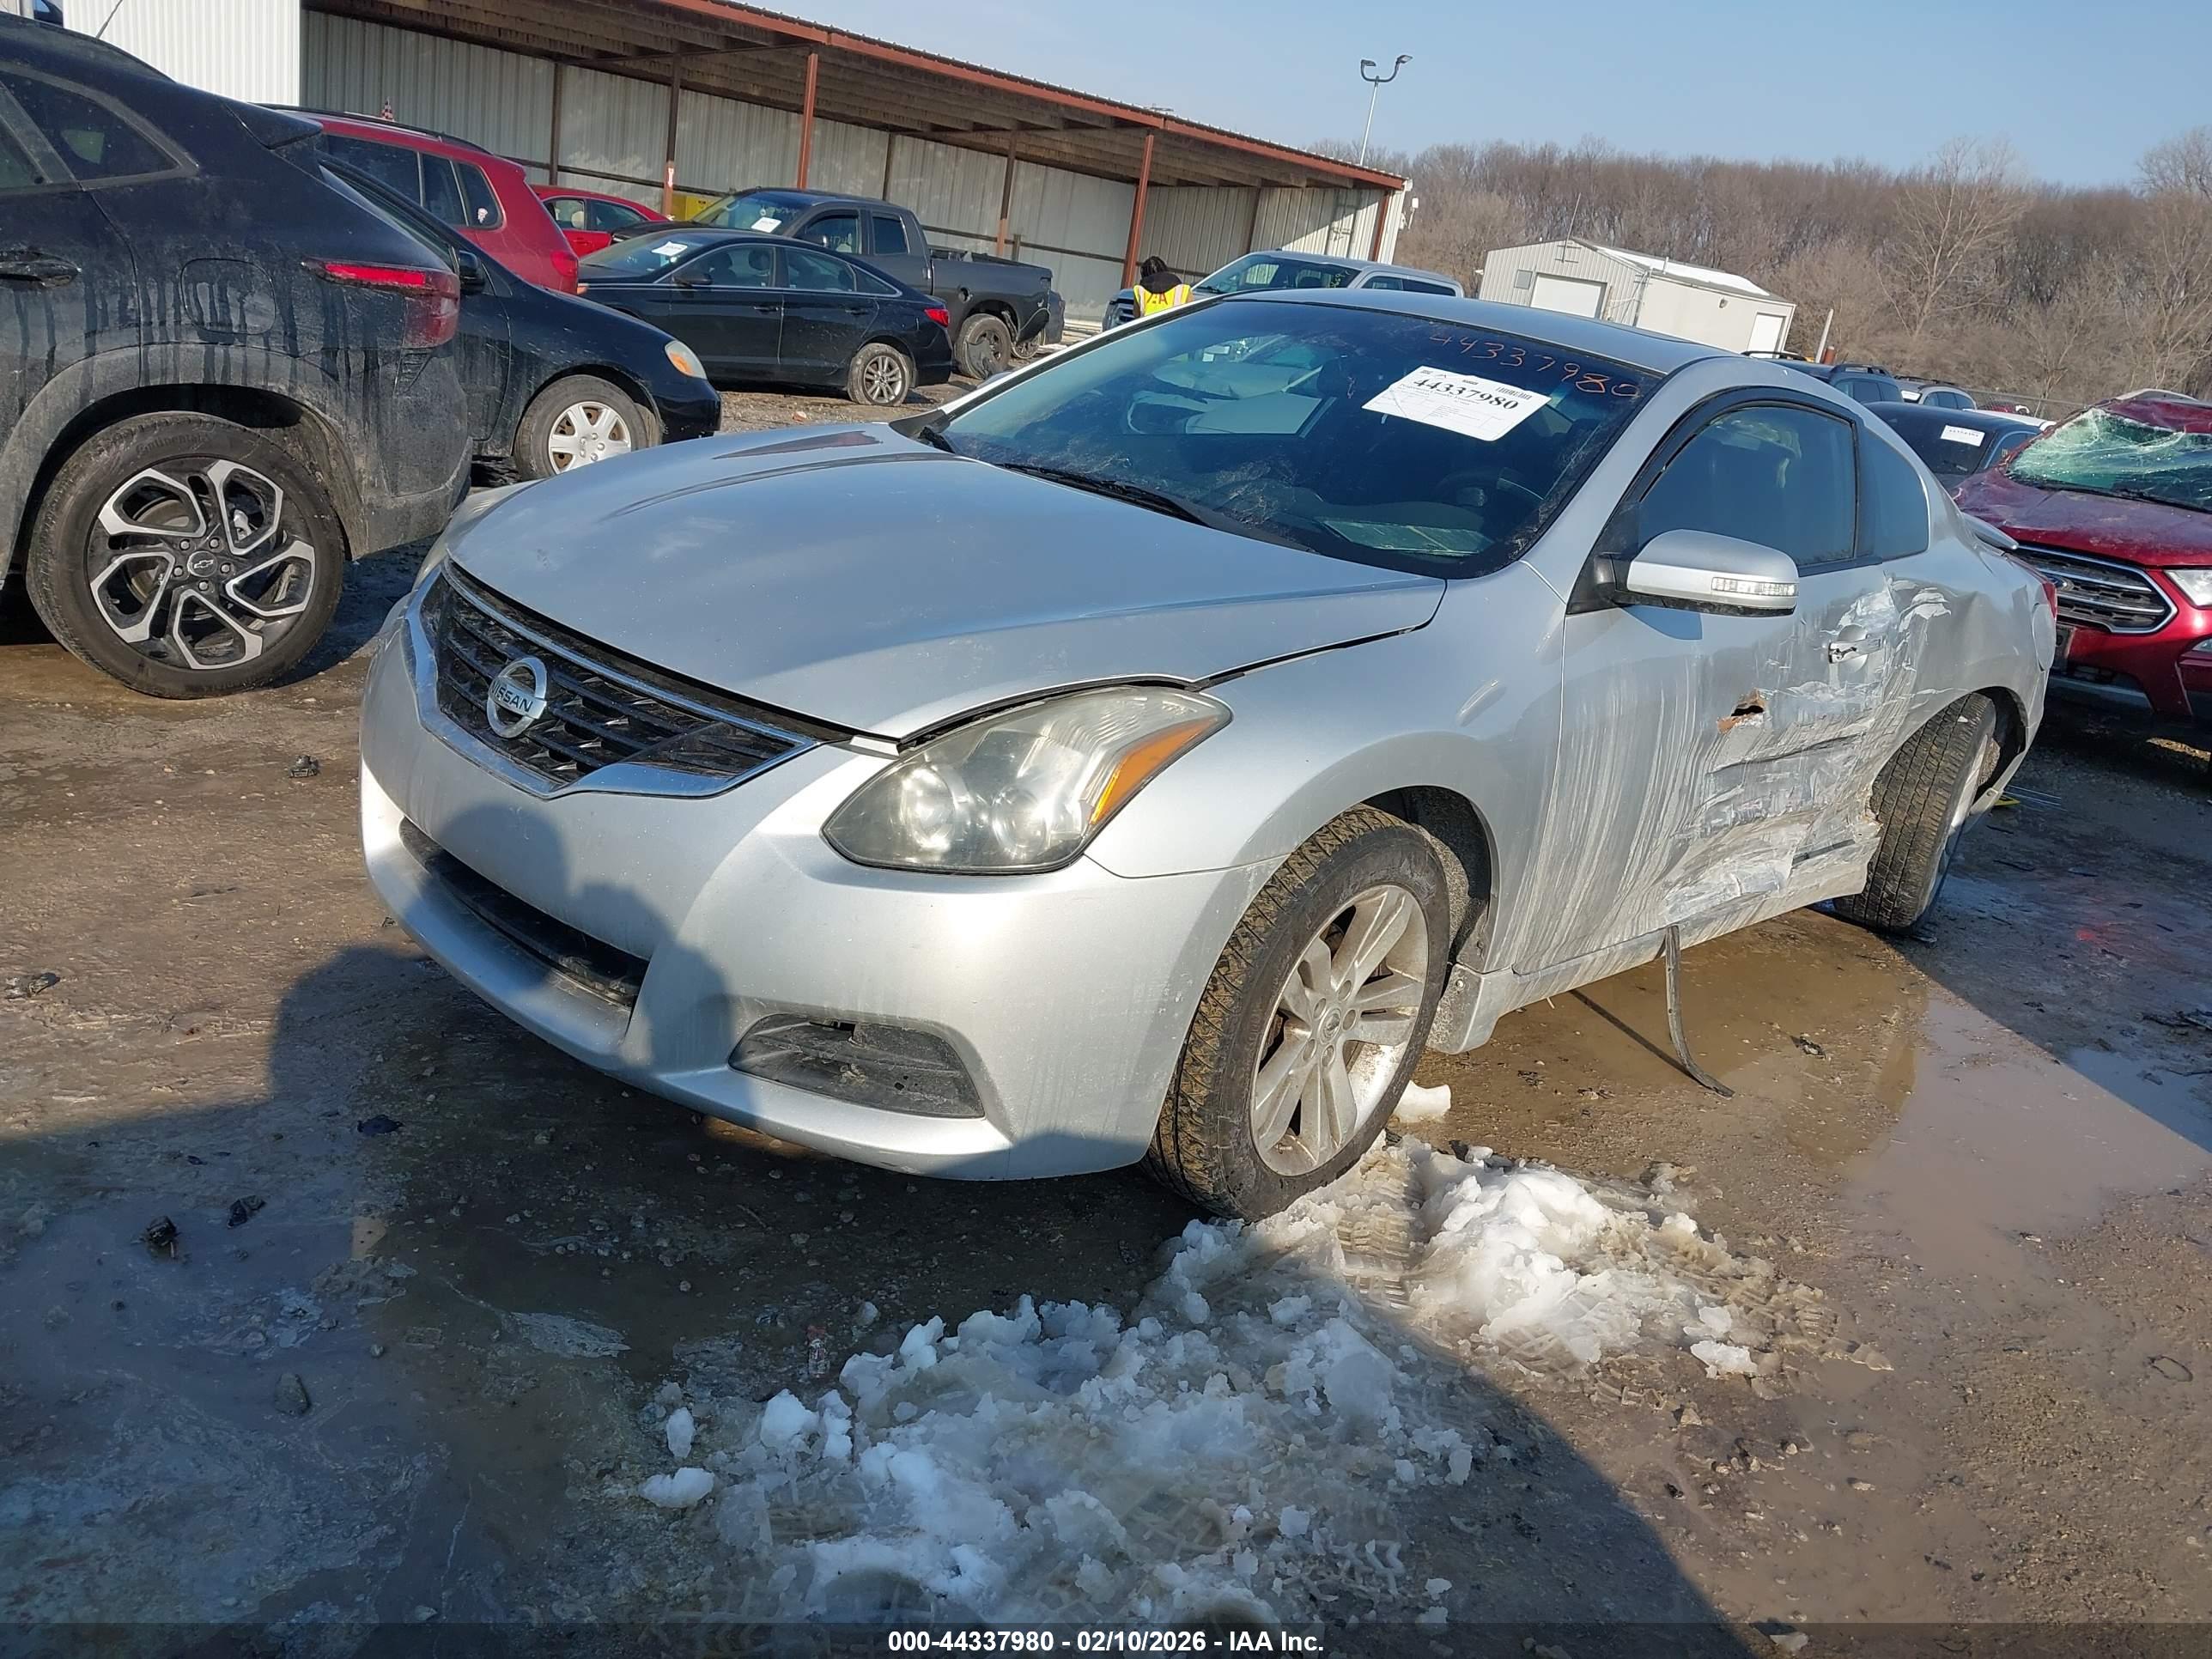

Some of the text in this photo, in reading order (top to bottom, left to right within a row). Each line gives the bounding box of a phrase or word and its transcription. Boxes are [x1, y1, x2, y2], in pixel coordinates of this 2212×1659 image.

[1429, 335, 1639, 398] 44337980
[1413, 378, 1519, 410] 44337980
[490, 679, 533, 713] NISSAN
